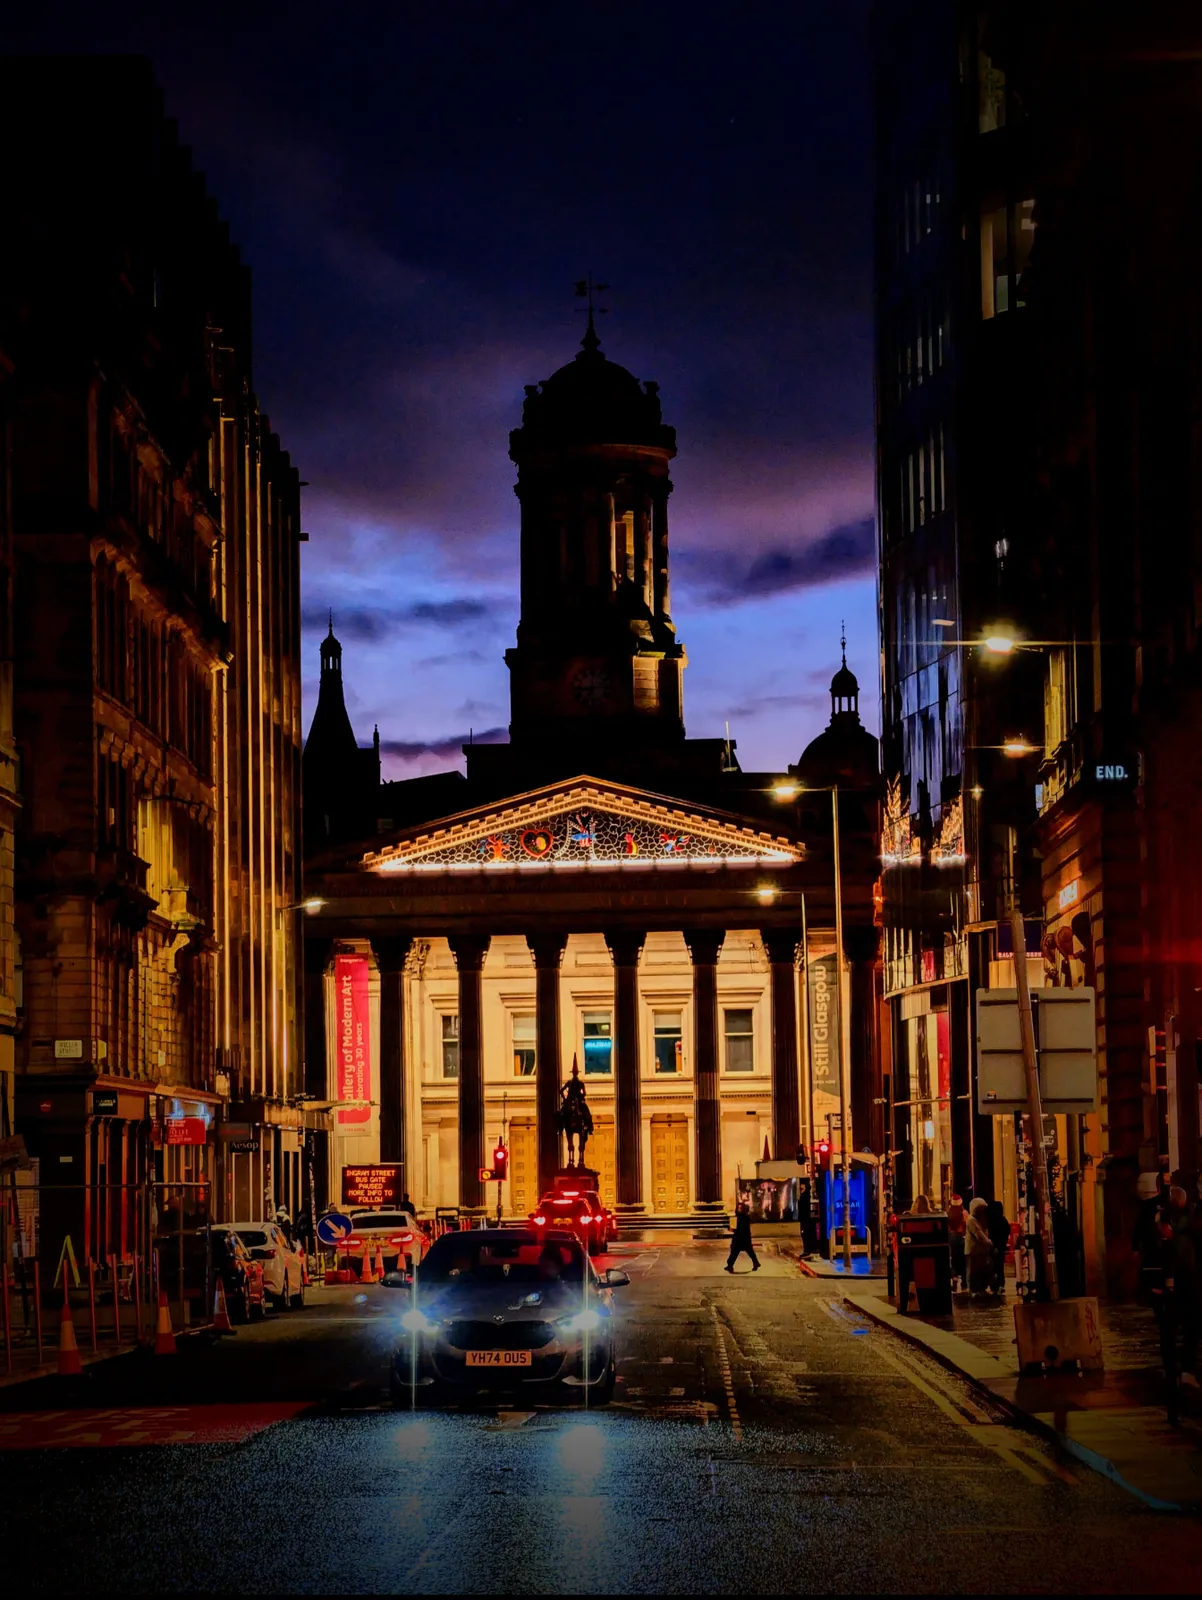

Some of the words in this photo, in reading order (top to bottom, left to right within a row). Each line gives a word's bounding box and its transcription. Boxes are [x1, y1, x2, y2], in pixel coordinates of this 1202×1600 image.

[1095, 765, 1129, 780] END.
[342, 975, 352, 996] Art
[813, 965, 831, 1041] Glasgow
[342, 998, 353, 1047] Modern
[356, 1022, 364, 1046] years
[342, 1048, 353, 1063] of
[356, 1048, 363, 1059] 30
[814, 1043, 829, 1076] Still
[231, 1141, 259, 1151] Aesop
[471, 1352, 501, 1363] YH74
[504, 1352, 527, 1363] OUS
